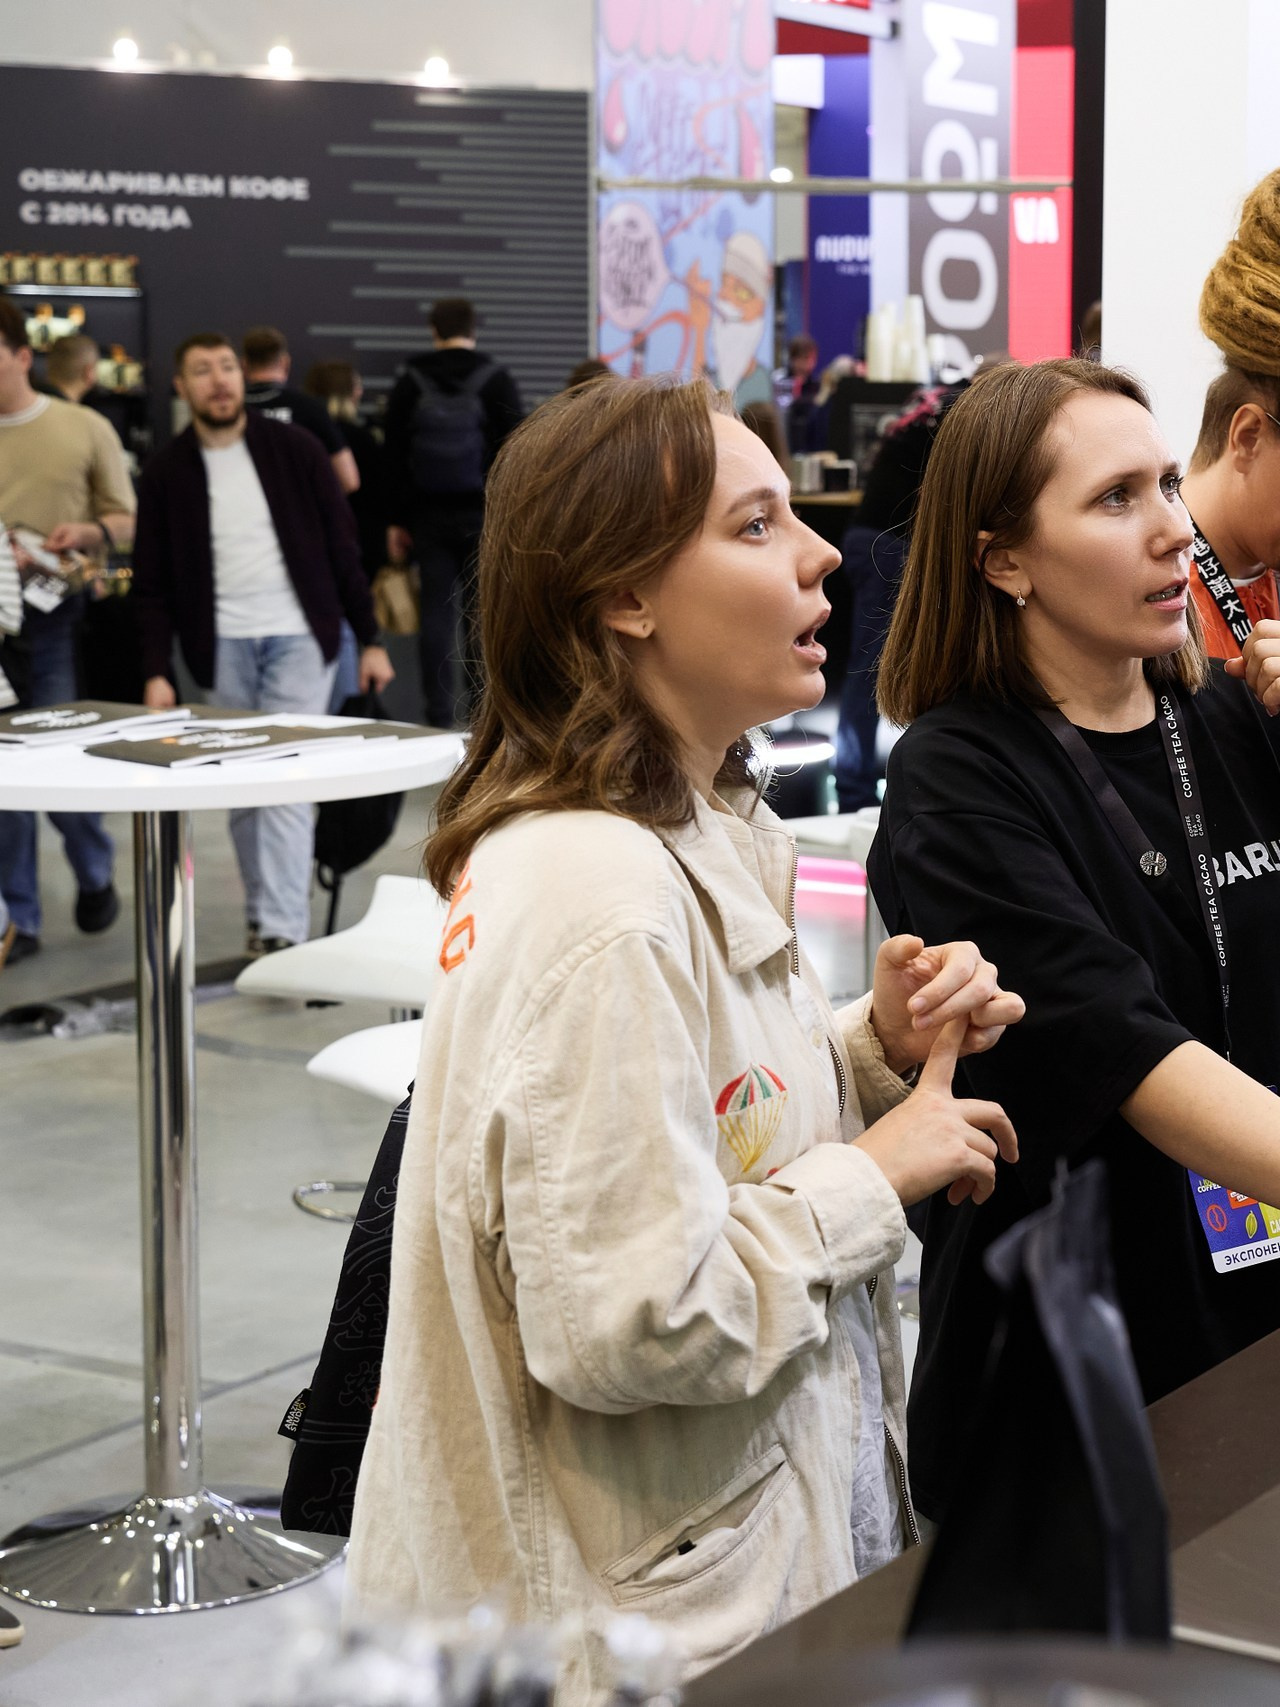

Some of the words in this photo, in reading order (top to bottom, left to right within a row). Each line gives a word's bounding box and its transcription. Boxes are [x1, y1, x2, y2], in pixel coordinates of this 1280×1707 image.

[18, 167, 225, 198] ОБЖАРИВАЕМ
[228, 175, 311, 201] КОФЕ
[45, 202, 110, 226] 2014
[112, 204, 193, 231] ГОДА
[1160, 695, 1178, 730] CACAO
[1170, 731, 1184, 755] TEA
[1175, 756, 1194, 799] COFFEE
[1184, 815, 1195, 838] COFFEE
[1191, 824, 1199, 837] TEA
[1195, 814, 1205, 837] CACAO
[1197, 853, 1215, 895] CACAO
[1207, 897, 1220, 922] TEA
[1213, 924, 1227, 967] COFFEE
[290, 1402, 307, 1433] STUDIO
